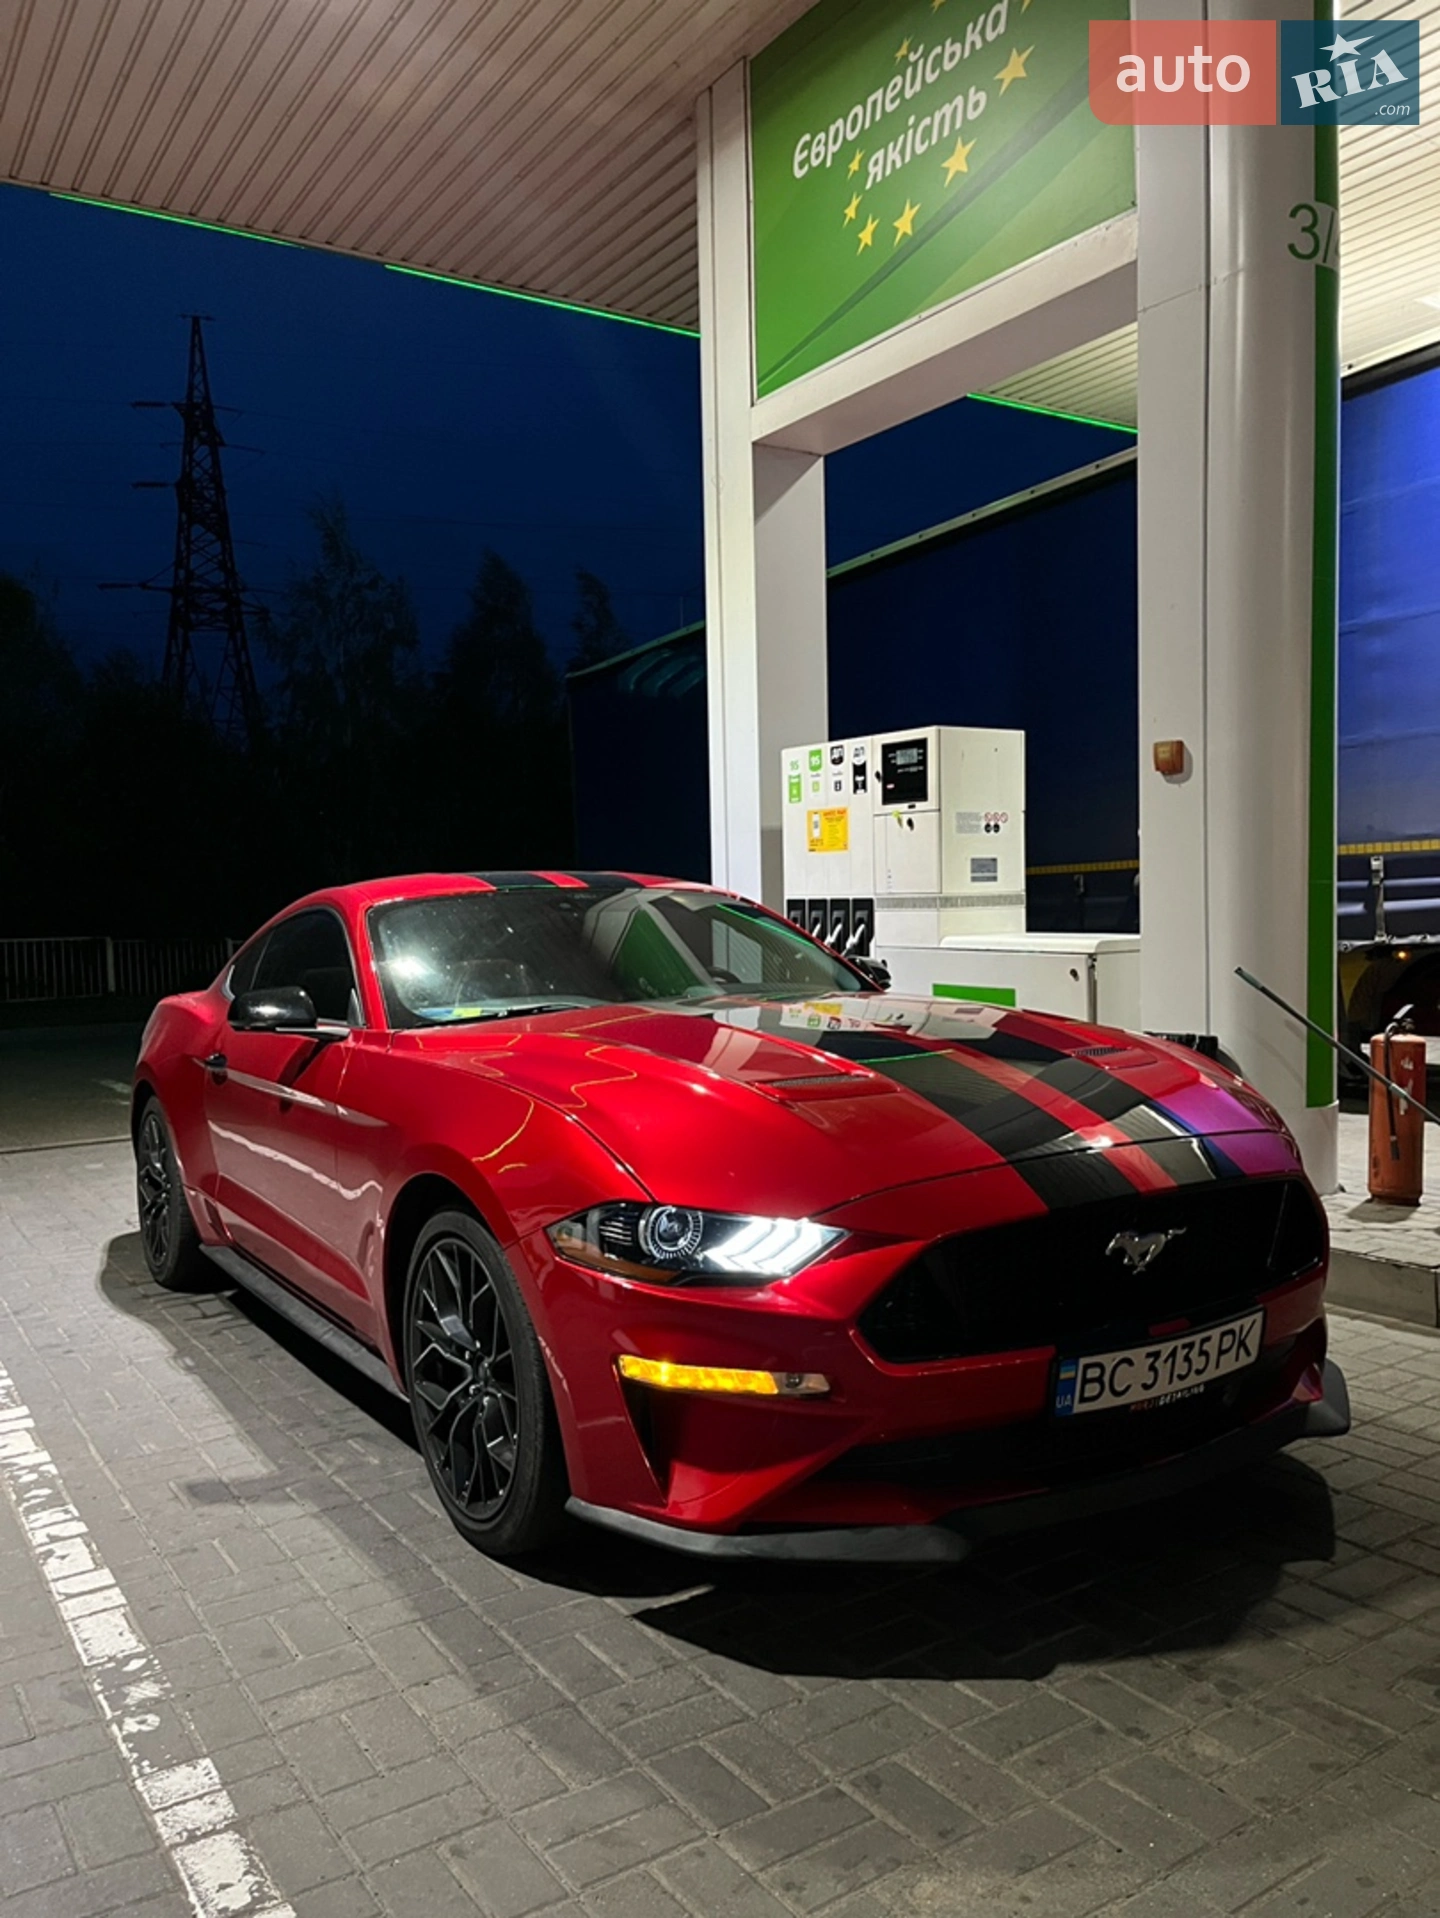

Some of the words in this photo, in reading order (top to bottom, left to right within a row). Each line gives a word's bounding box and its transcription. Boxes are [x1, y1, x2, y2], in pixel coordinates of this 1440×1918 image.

[793, 0, 1008, 179] Європейська
[865, 85, 987, 190] якість
[1287, 203, 1340, 263] 3/
[1055, 1395, 1073, 1408] UA
[1078, 1356, 1135, 1405] BC
[1141, 1335, 1212, 1391] 3135
[1215, 1318, 1257, 1370] PK
